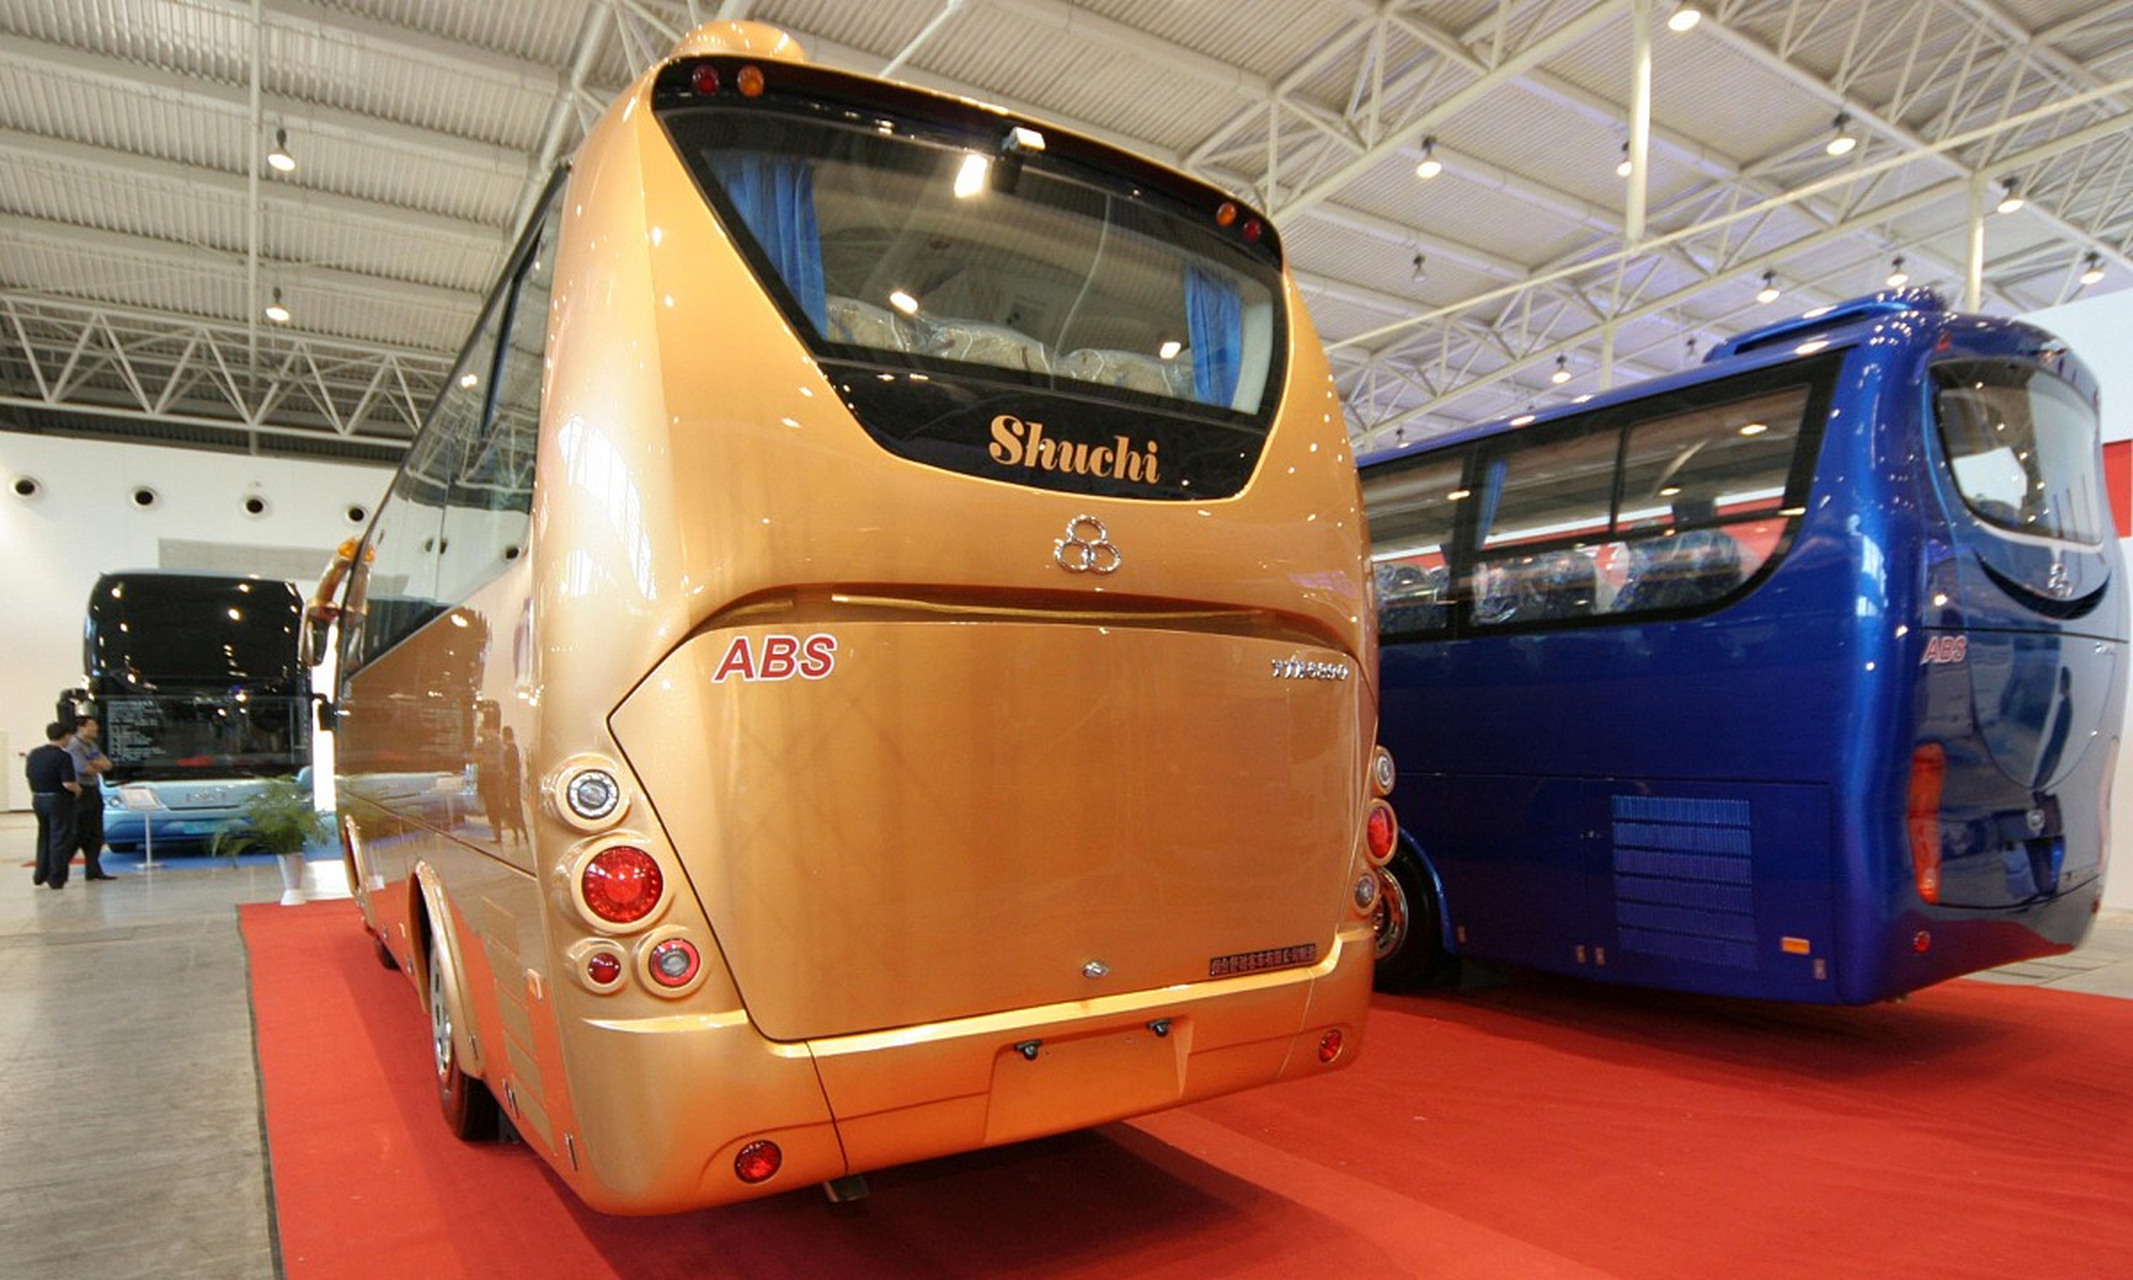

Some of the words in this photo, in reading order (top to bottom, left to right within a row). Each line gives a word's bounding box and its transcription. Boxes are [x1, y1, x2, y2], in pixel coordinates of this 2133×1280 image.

[989, 415, 1160, 484] Shuchi
[711, 633, 838, 683] ABS
[1920, 635, 1968, 665] ABS
